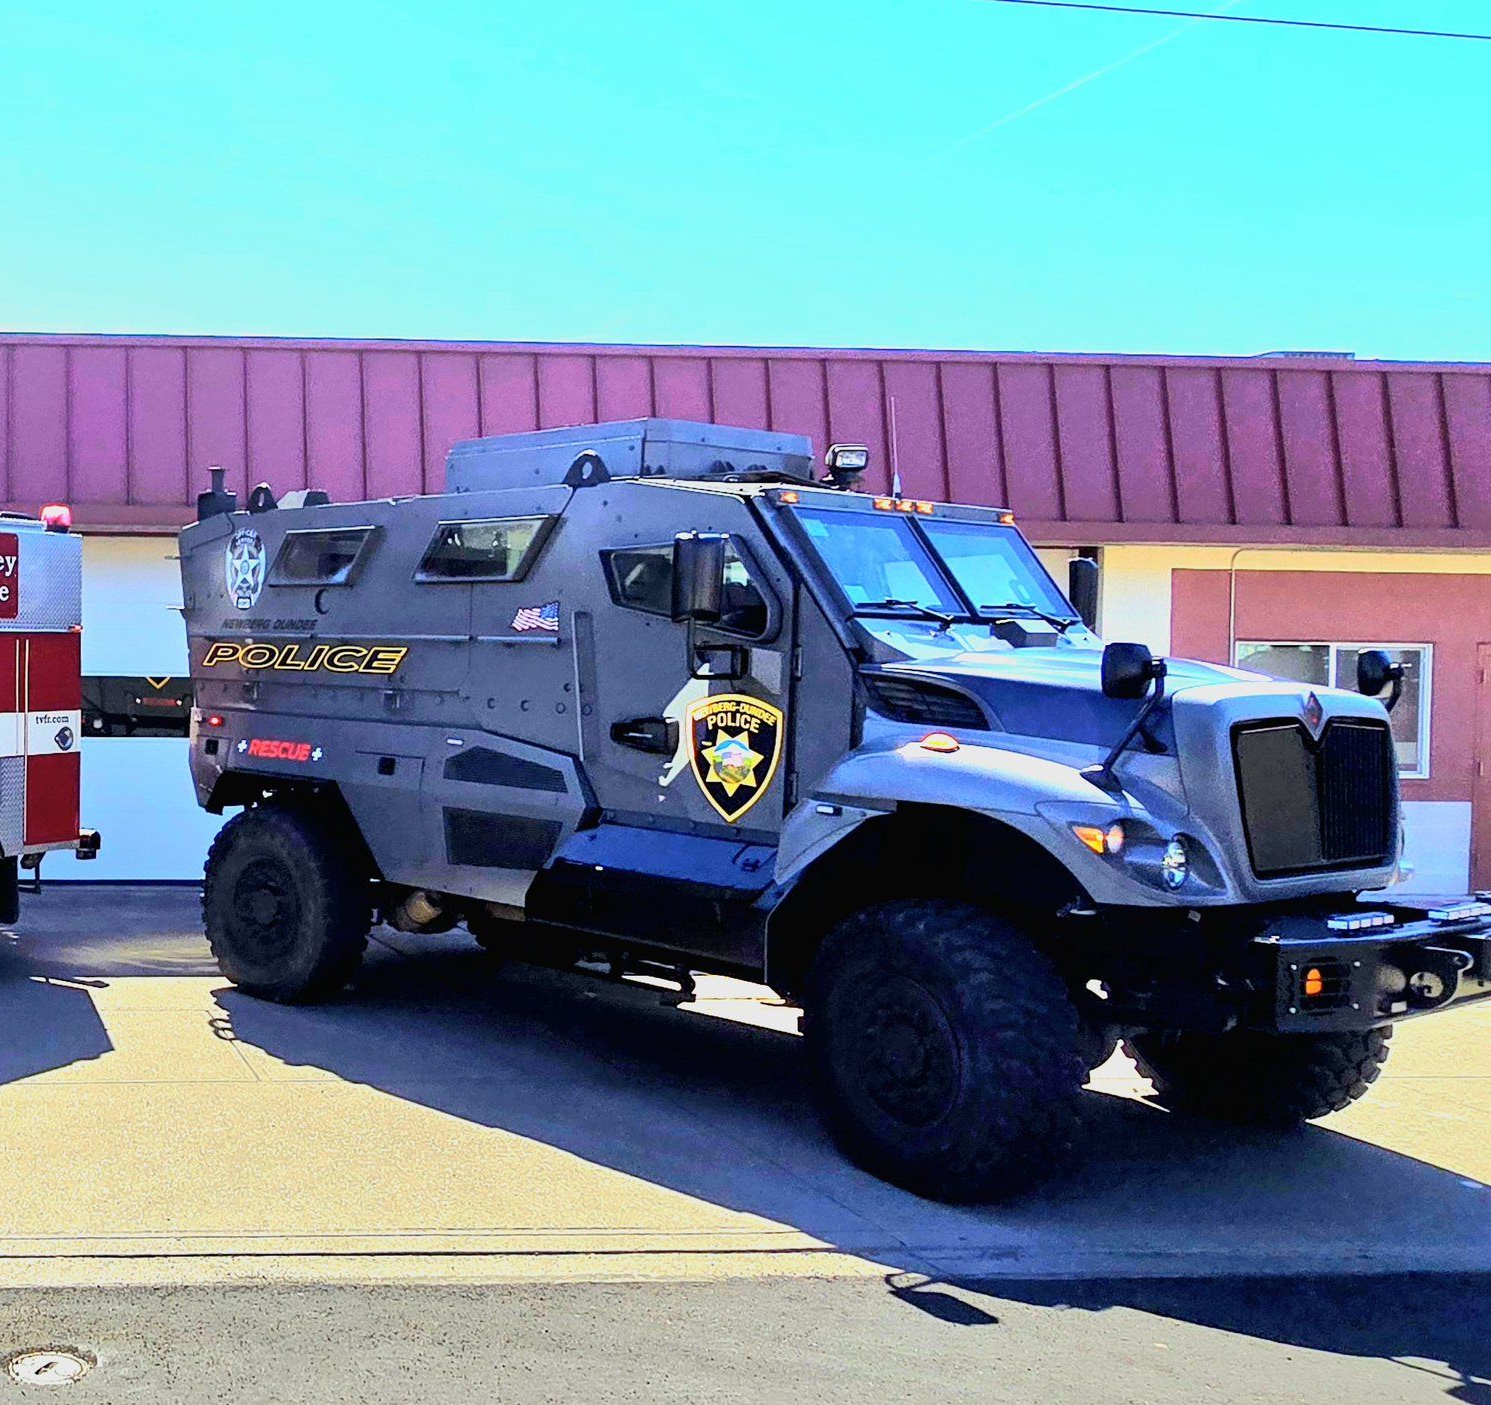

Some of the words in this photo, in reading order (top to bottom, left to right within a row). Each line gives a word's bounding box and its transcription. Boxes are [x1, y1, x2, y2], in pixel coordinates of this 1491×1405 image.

[221, 619, 271, 630] NEWBERG
[273, 619, 318, 631] DUNDEE
[203, 643, 407, 673] POLICE
[693, 702, 777, 726] WBERG-DUNDEE
[707, 712, 761, 733] POLICE
[248, 739, 311, 761] RESCUE
